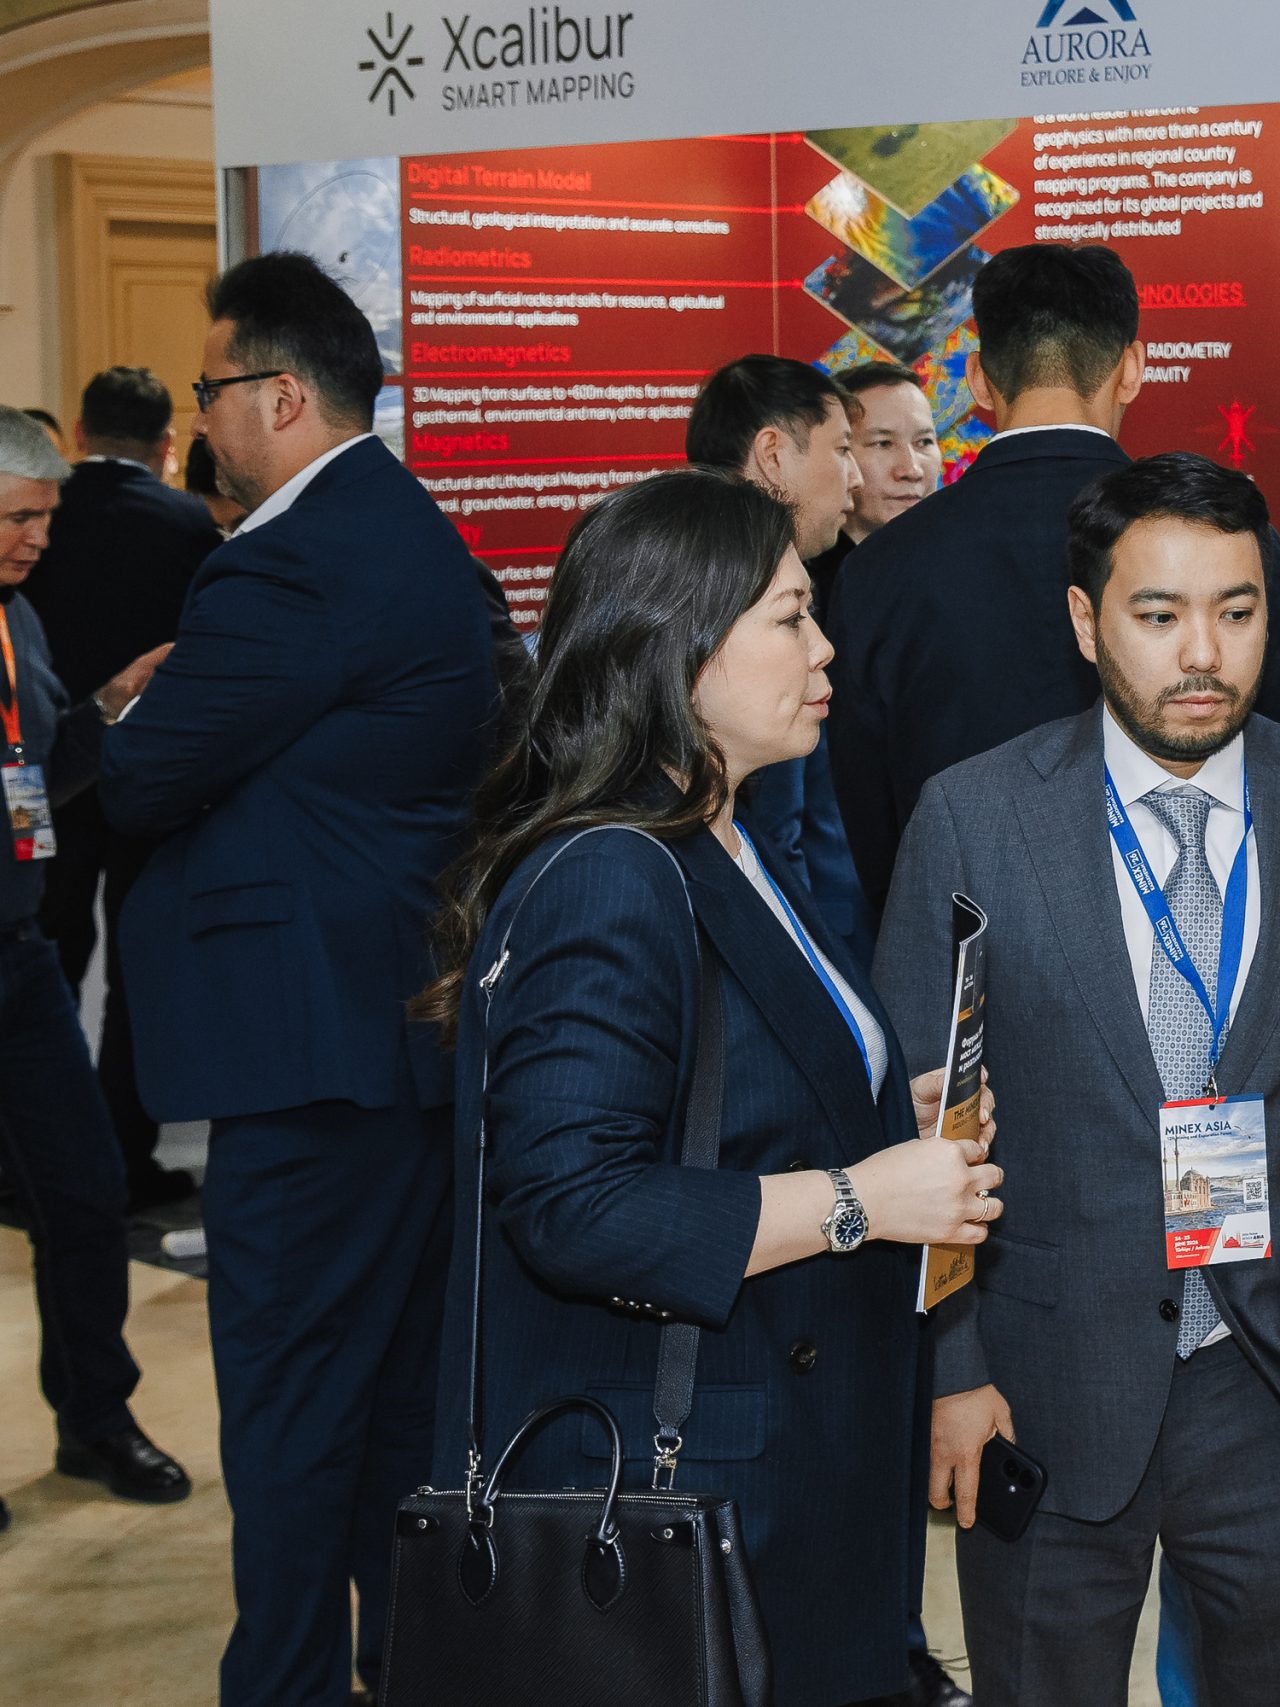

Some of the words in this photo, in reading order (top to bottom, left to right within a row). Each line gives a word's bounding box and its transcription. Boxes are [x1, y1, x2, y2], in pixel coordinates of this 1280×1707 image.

[441, 6, 634, 72] Xcalibur
[1021, 27, 1152, 64] AURORA
[1020, 68, 1086, 87] EXPLORE
[1089, 67, 1100, 83] &
[1104, 63, 1152, 84] ENJOY
[442, 80, 520, 111] SMART
[526, 71, 635, 105] MAPPING
[1033, 128, 1105, 151] geophysics
[1105, 125, 1134, 143] with
[1134, 126, 1168, 142] more
[1168, 122, 1200, 140] than
[1200, 124, 1210, 138] a
[1210, 120, 1263, 139] century
[1033, 153, 1048, 171] of
[1048, 150, 1118, 172] experience
[1118, 149, 1131, 167] in
[1131, 146, 1184, 169] regional
[1184, 144, 1237, 164] country
[407, 163, 468, 189] Digital
[471, 165, 534, 189] Terrain
[536, 169, 592, 192] Model
[1034, 176, 1088, 196] mapping
[1088, 173, 1150, 195] programs.
[1152, 169, 1178, 188] The
[1178, 168, 1238, 190] company
[1238, 166, 1252, 185] is
[1034, 198, 1103, 219] recognized
[1103, 195, 1122, 214] for
[1122, 194, 1140, 213] its
[1140, 193, 1181, 217] global
[1181, 191, 1236, 215] projects
[1236, 190, 1263, 209] and
[472, 211, 530, 231] geological
[531, 212, 607, 232] interpretation
[607, 215, 630, 231] and
[630, 217, 674, 233] accurate
[674, 219, 730, 235] corrections
[1034, 221, 1110, 242] strategically
[1110, 218, 1182, 239] distributed
[409, 244, 532, 269] Radiometrics
[410, 290, 462, 310] Mapping
[462, 290, 477, 307] of
[522, 291, 552, 308] rocks
[552, 292, 577, 308] and
[602, 292, 618, 308] for
[669, 293, 725, 312] agricultural
[411, 310, 435, 326] and
[435, 310, 514, 326] environmental
[514, 311, 579, 329] applications
[411, 341, 572, 368] Electromagnetics
[1147, 341, 1232, 360] RADIOMETRY
[412, 386, 430, 403] 3D
[430, 386, 482, 405] Mapping
[482, 385, 508, 402] from
[508, 384, 553, 401] surface
[553, 385, 568, 401] to
[604, 383, 645, 403] depths
[645, 383, 661, 400] for
[484, 407, 565, 423] environmental
[565, 406, 590, 422] and
[590, 406, 617, 424] many
[617, 405, 647, 420] other
[412, 431, 510, 457] Magnetics
[473, 474, 497, 490] and
[497, 472, 561, 491] Lithological
[561, 470, 609, 489] Mapping
[609, 468, 633, 485] from
[1131, 866, 1150, 894] MINEX
[1161, 932, 1180, 962] MINEX
[1165, 1123, 1202, 1135] MINEX
[1205, 1121, 1232, 1132] ASIA
